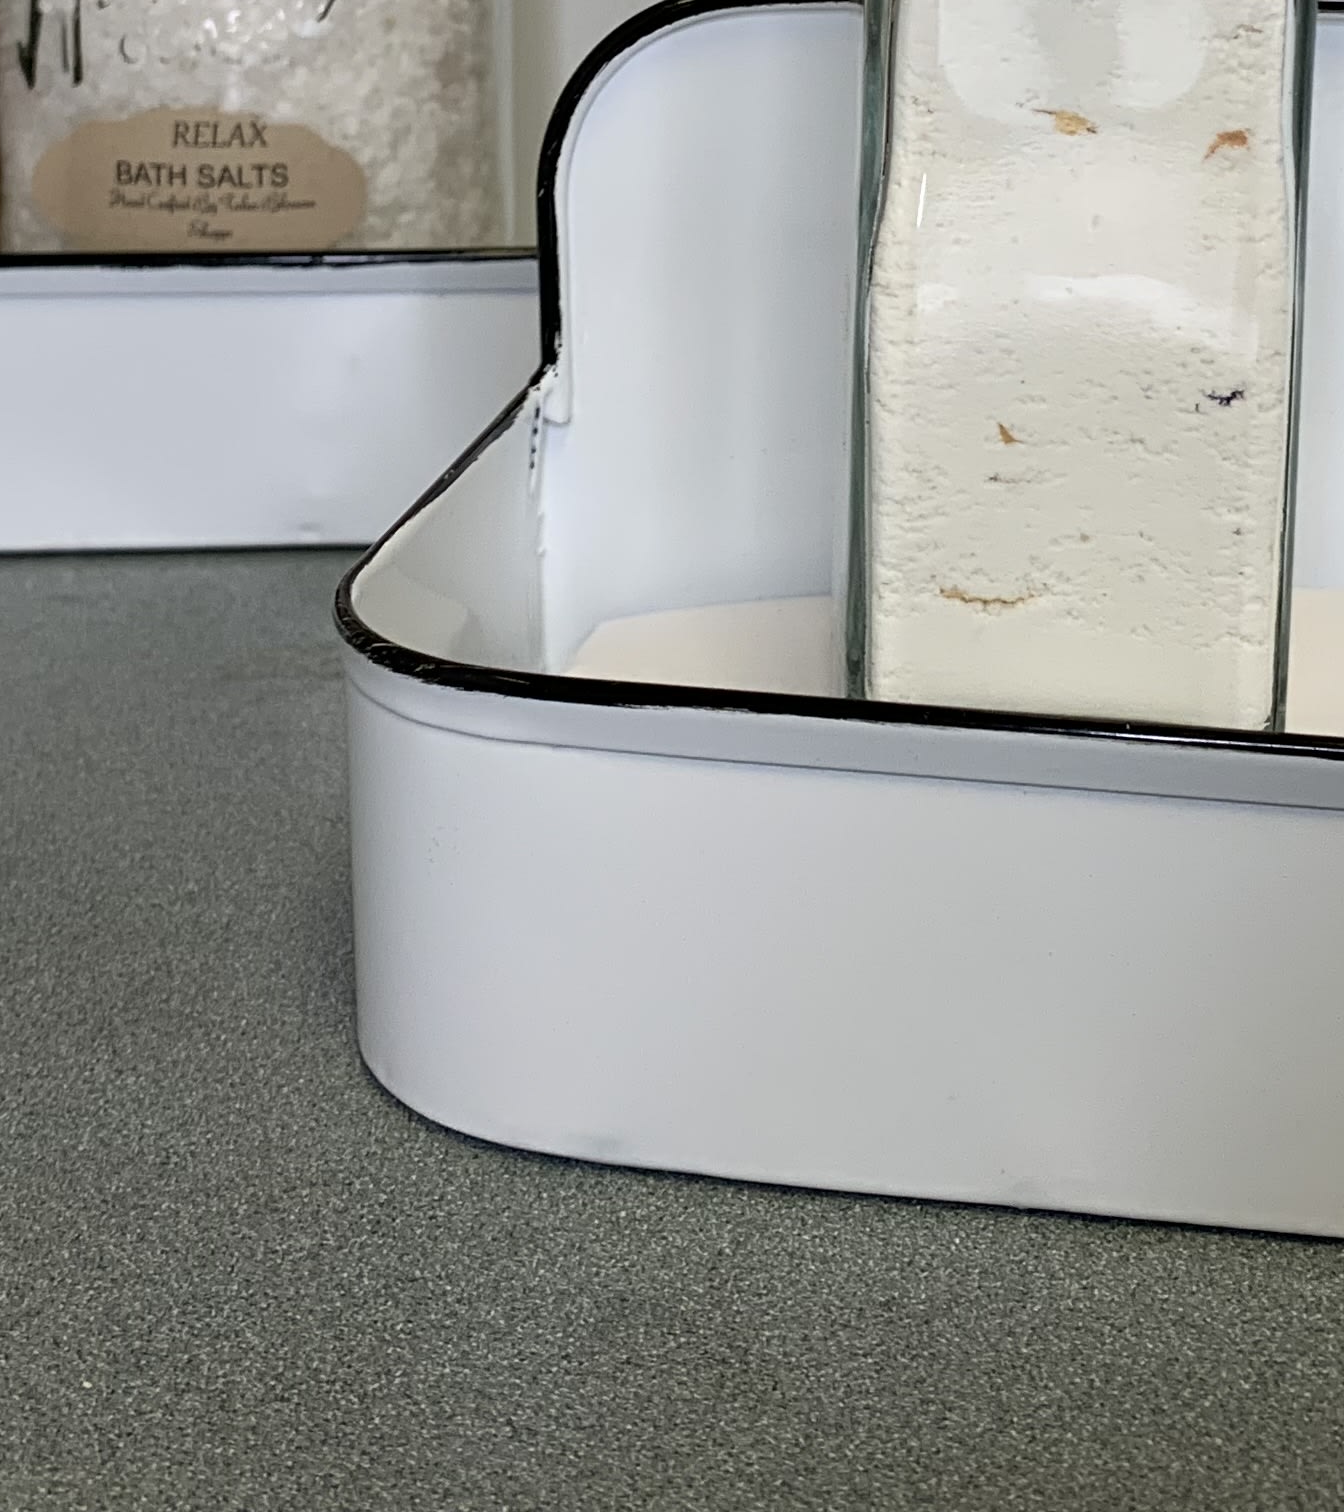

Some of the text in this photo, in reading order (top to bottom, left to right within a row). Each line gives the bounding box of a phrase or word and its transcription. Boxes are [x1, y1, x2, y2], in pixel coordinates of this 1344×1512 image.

[172, 120, 268, 148] RELAX
[115, 159, 289, 189] BATH SALTS
